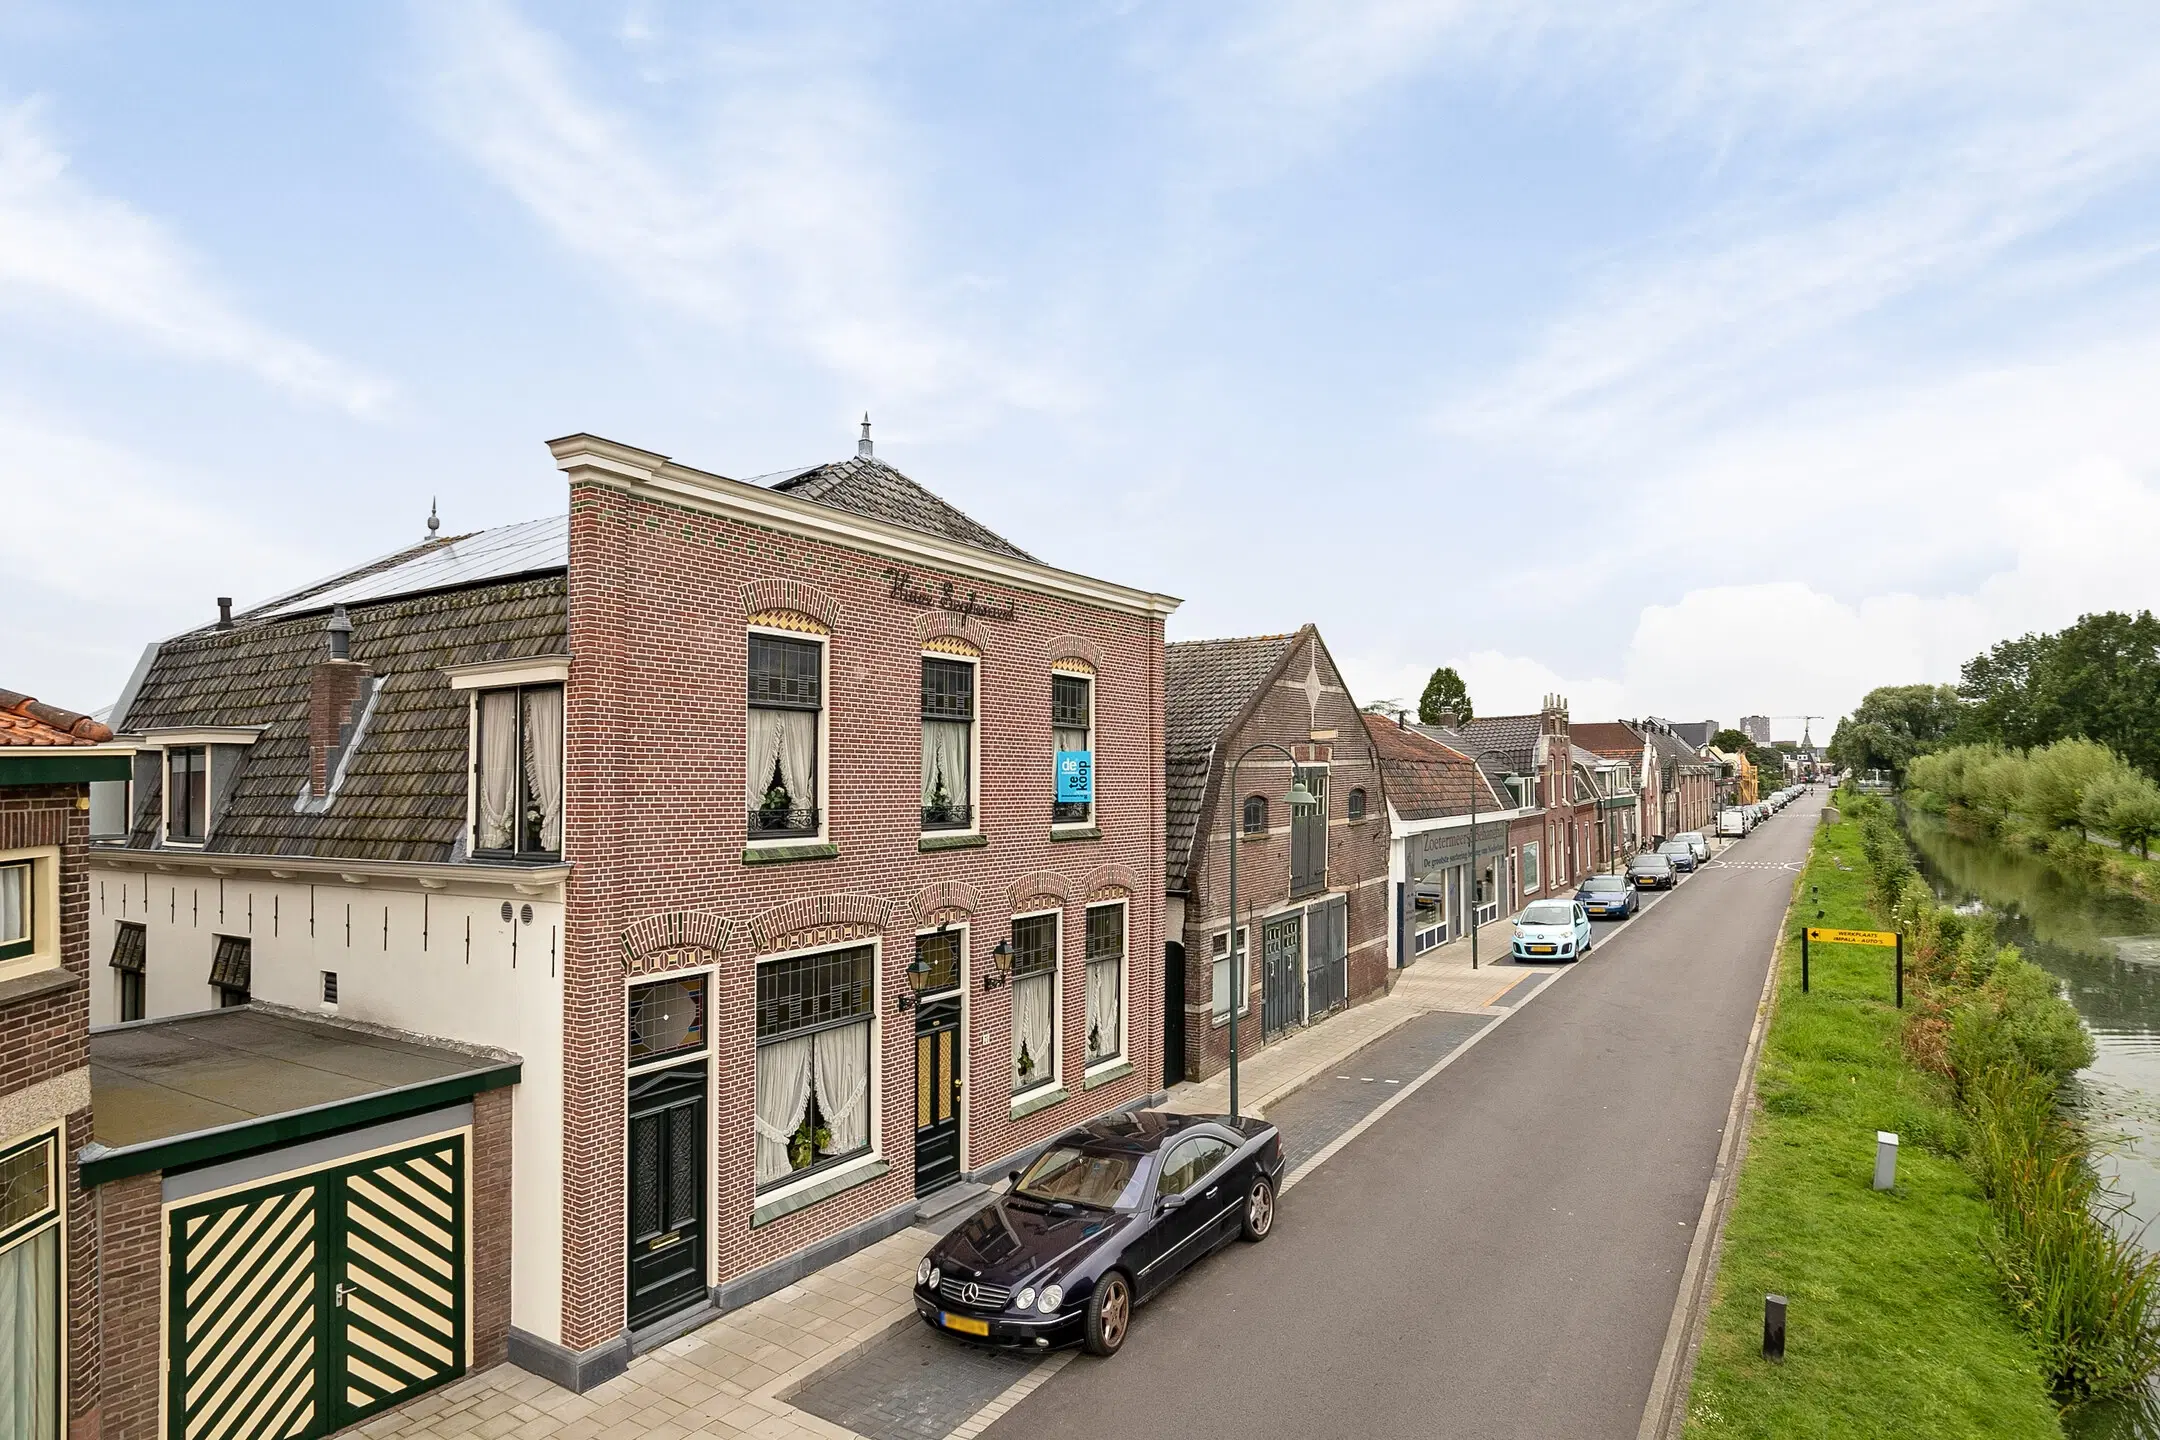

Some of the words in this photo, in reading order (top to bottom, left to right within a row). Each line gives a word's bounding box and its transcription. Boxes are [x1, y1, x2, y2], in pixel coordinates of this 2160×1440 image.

[1062, 758, 1077, 771] de
[1076, 760, 1091, 791] koop
[1069, 776, 1079, 789] te
[1423, 858, 1431, 868] De
